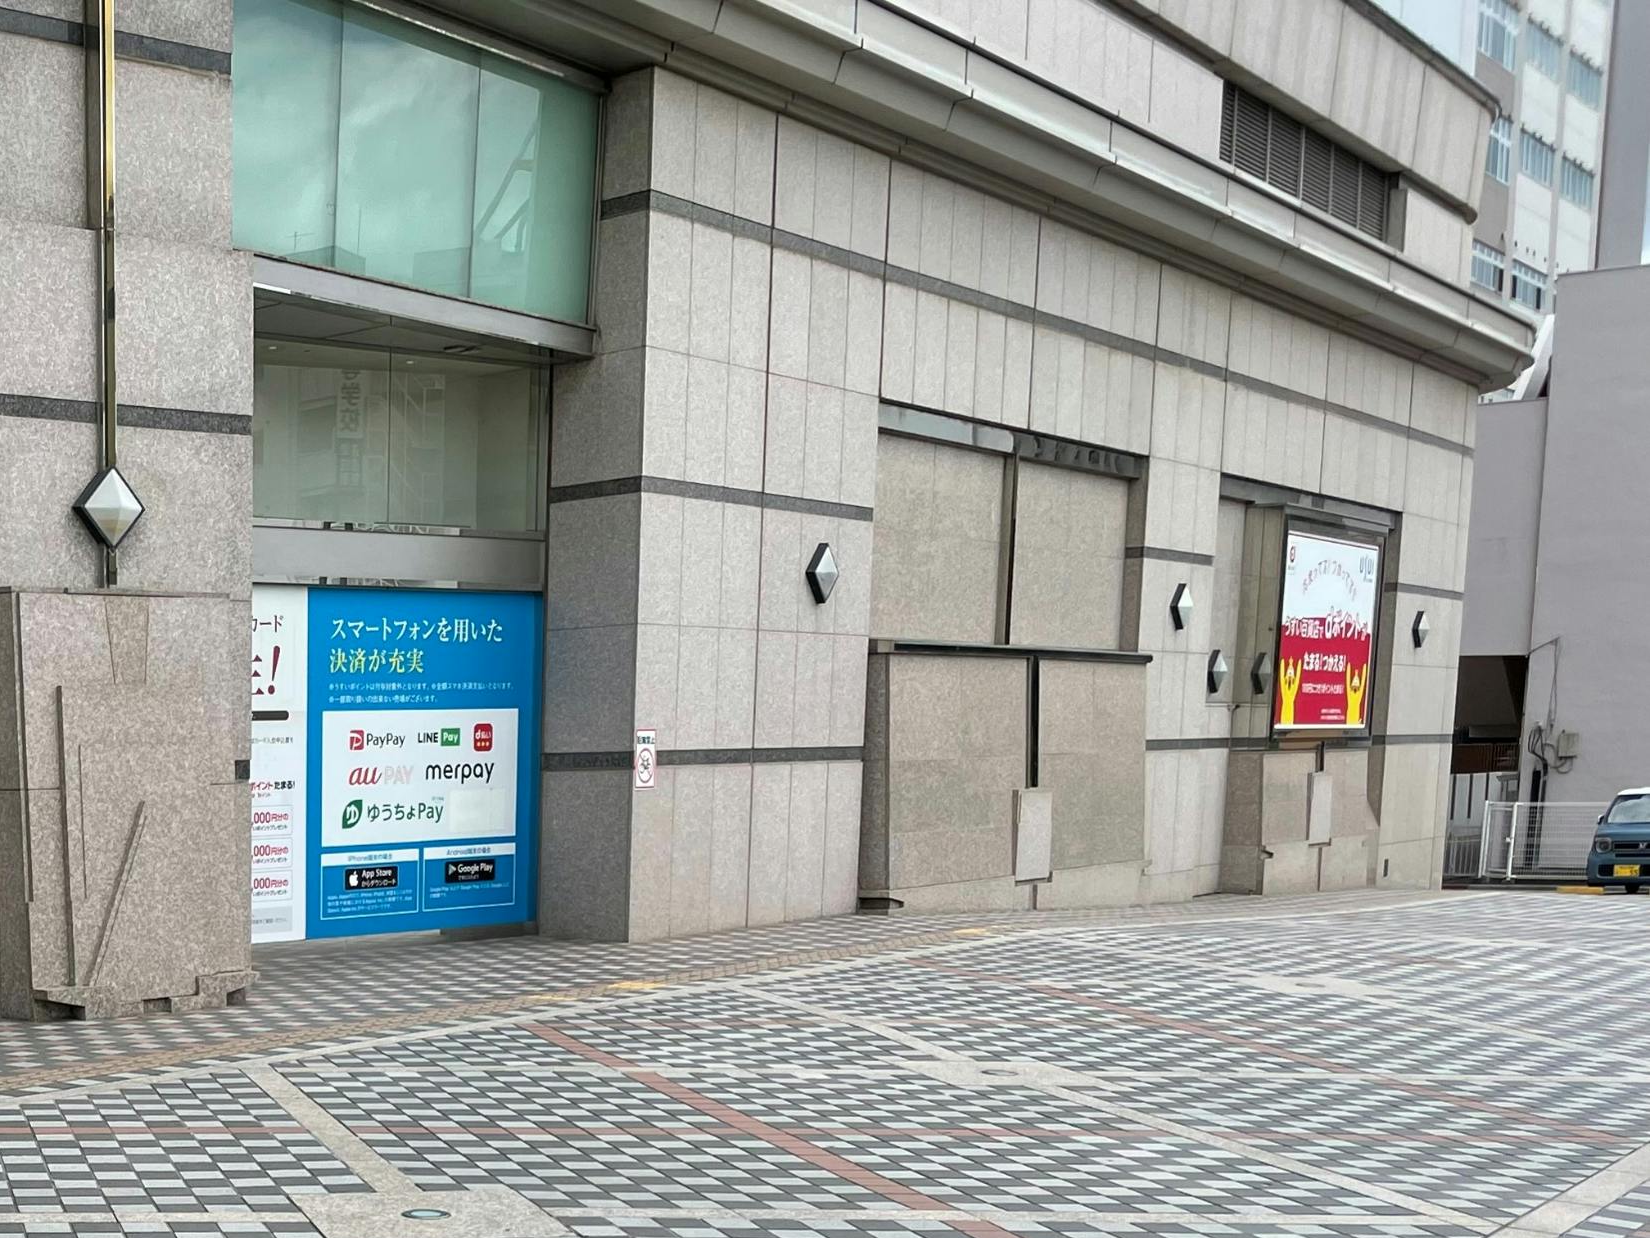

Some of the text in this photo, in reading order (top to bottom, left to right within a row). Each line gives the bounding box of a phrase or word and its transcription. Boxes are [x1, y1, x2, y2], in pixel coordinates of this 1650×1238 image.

[329, 617, 503, 642] スマートフォンを用いた
[329, 647, 425, 675] 決済が充実
[366, 732, 406, 748] PayPay
[417, 732, 459, 745] LINE Pay
[348, 765, 413, 786] au PAY
[425, 762, 494, 784] merpay
[367, 802, 444, 823] ゆうちょPay
[361, 868, 392, 879] App Store
[457, 863, 494, 874] Google Play
